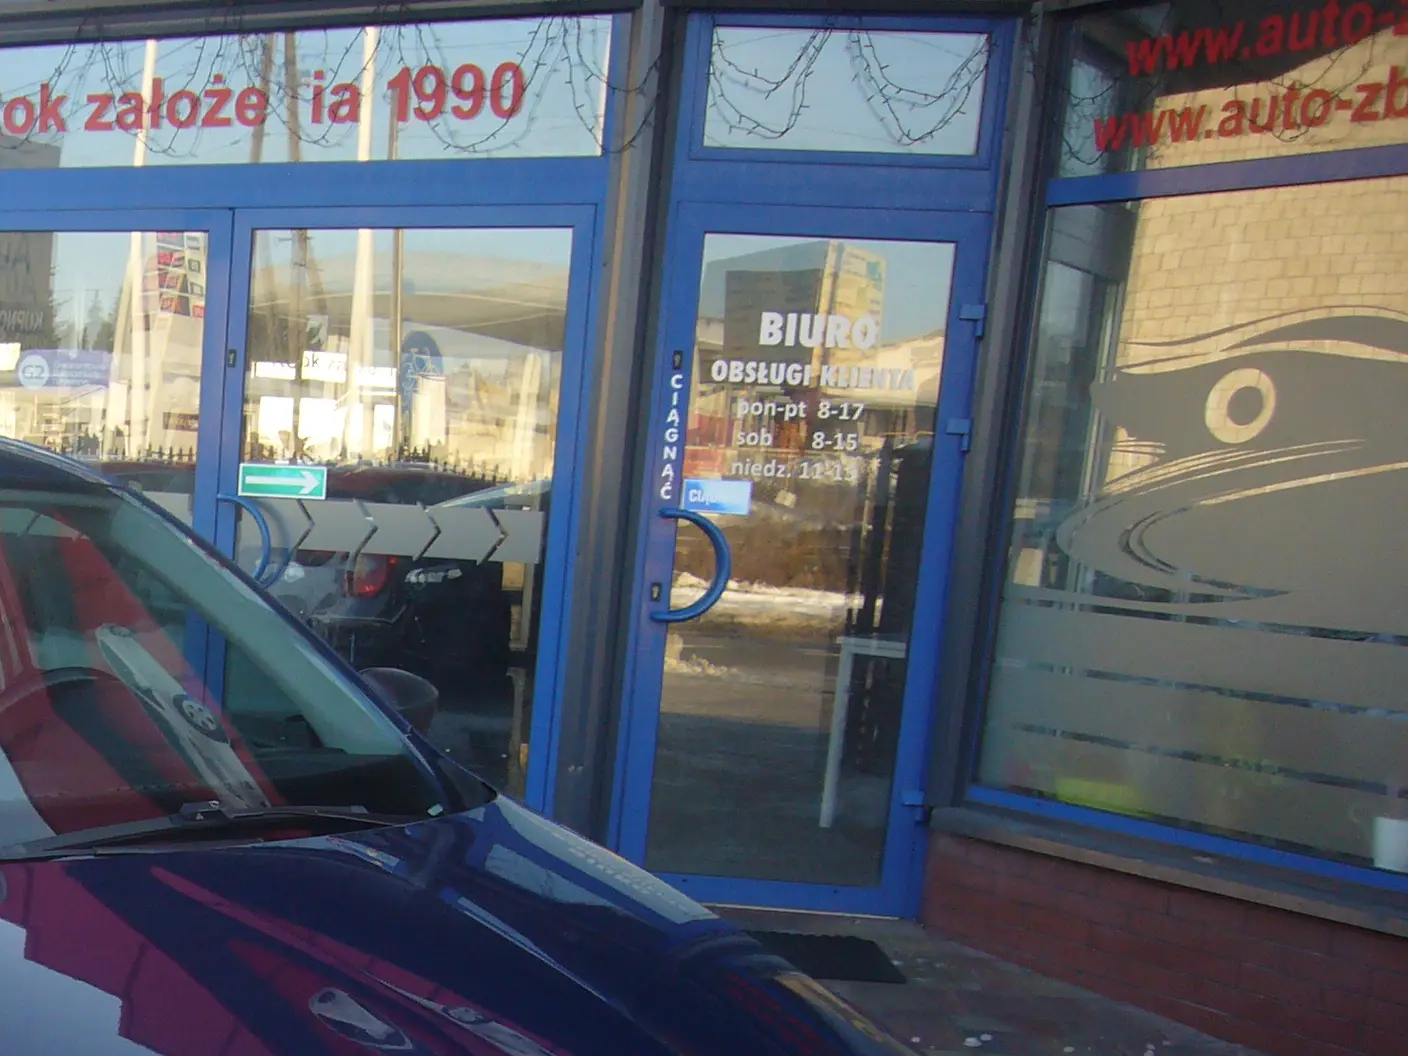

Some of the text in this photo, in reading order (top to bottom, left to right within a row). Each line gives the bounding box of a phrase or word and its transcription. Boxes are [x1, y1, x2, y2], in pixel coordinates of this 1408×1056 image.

[386, 61, 526, 122] 1990
[759, 311, 876, 349] BIURO
[21, 364, 46, 380] G2
[711, 359, 915, 391] OBSŁUGI KLIENTA
[736, 398, 865, 422] pon-pt 8-17
[660, 374, 683, 500] CIĄGNĄĆ
[736, 427, 858, 451] sob 8-15
[731, 459, 792, 480] niedz.
